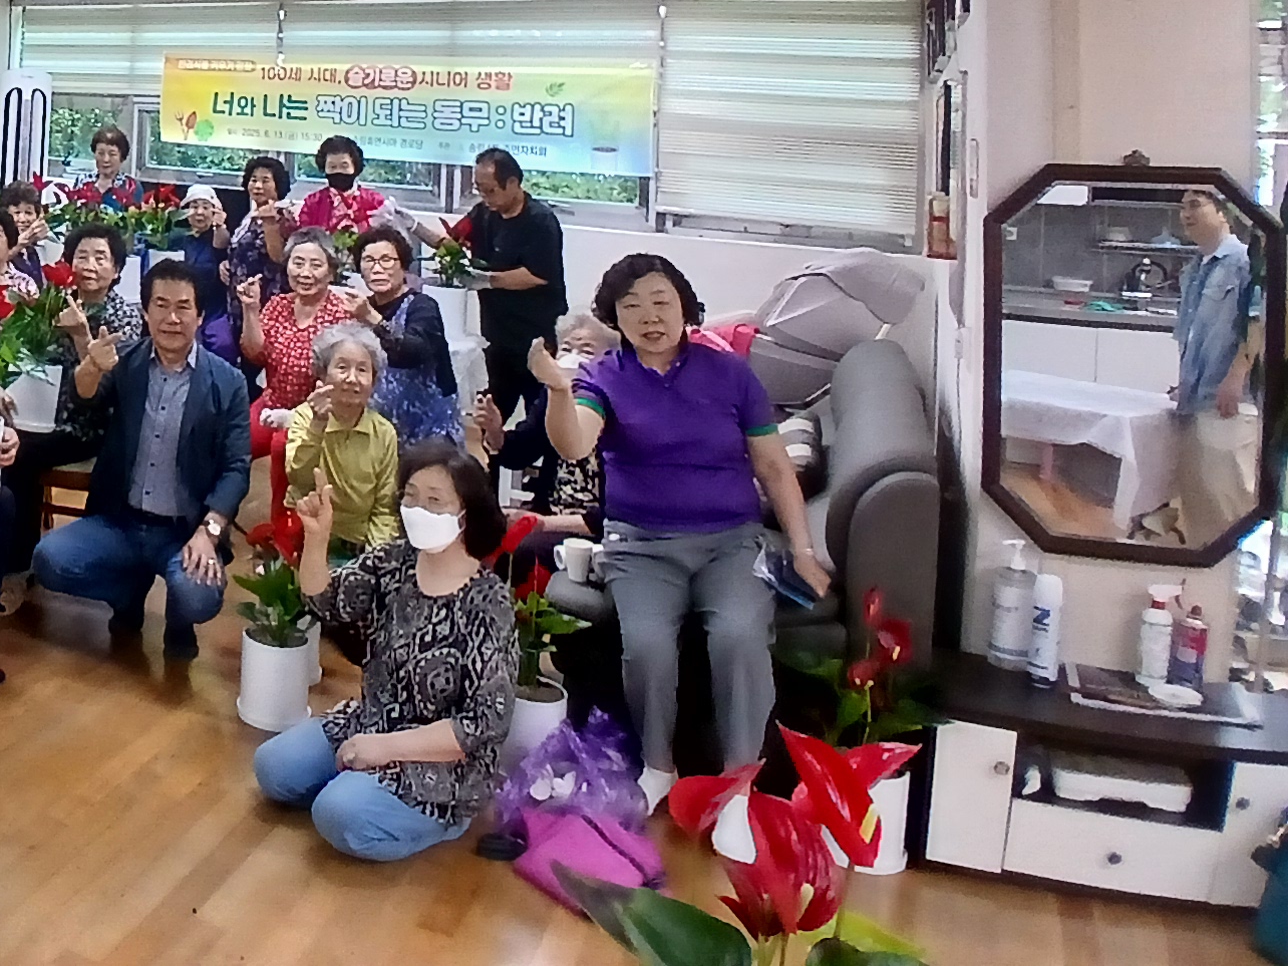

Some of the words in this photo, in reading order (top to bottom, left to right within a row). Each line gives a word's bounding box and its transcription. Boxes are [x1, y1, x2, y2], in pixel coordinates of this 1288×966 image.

[261, 66, 302, 82] 100세
[347, 66, 413, 90] 슬기로운
[420, 70, 468, 88] 시니어
[475, 71, 513, 91] 생활
[213, 92, 257, 116] 너와
[263, 93, 309, 121] 나는
[316, 94, 368, 125] 짝이
[372, 97, 428, 129] 되는
[432, 99, 491, 132] 동무
[512, 102, 574, 137] 반려
